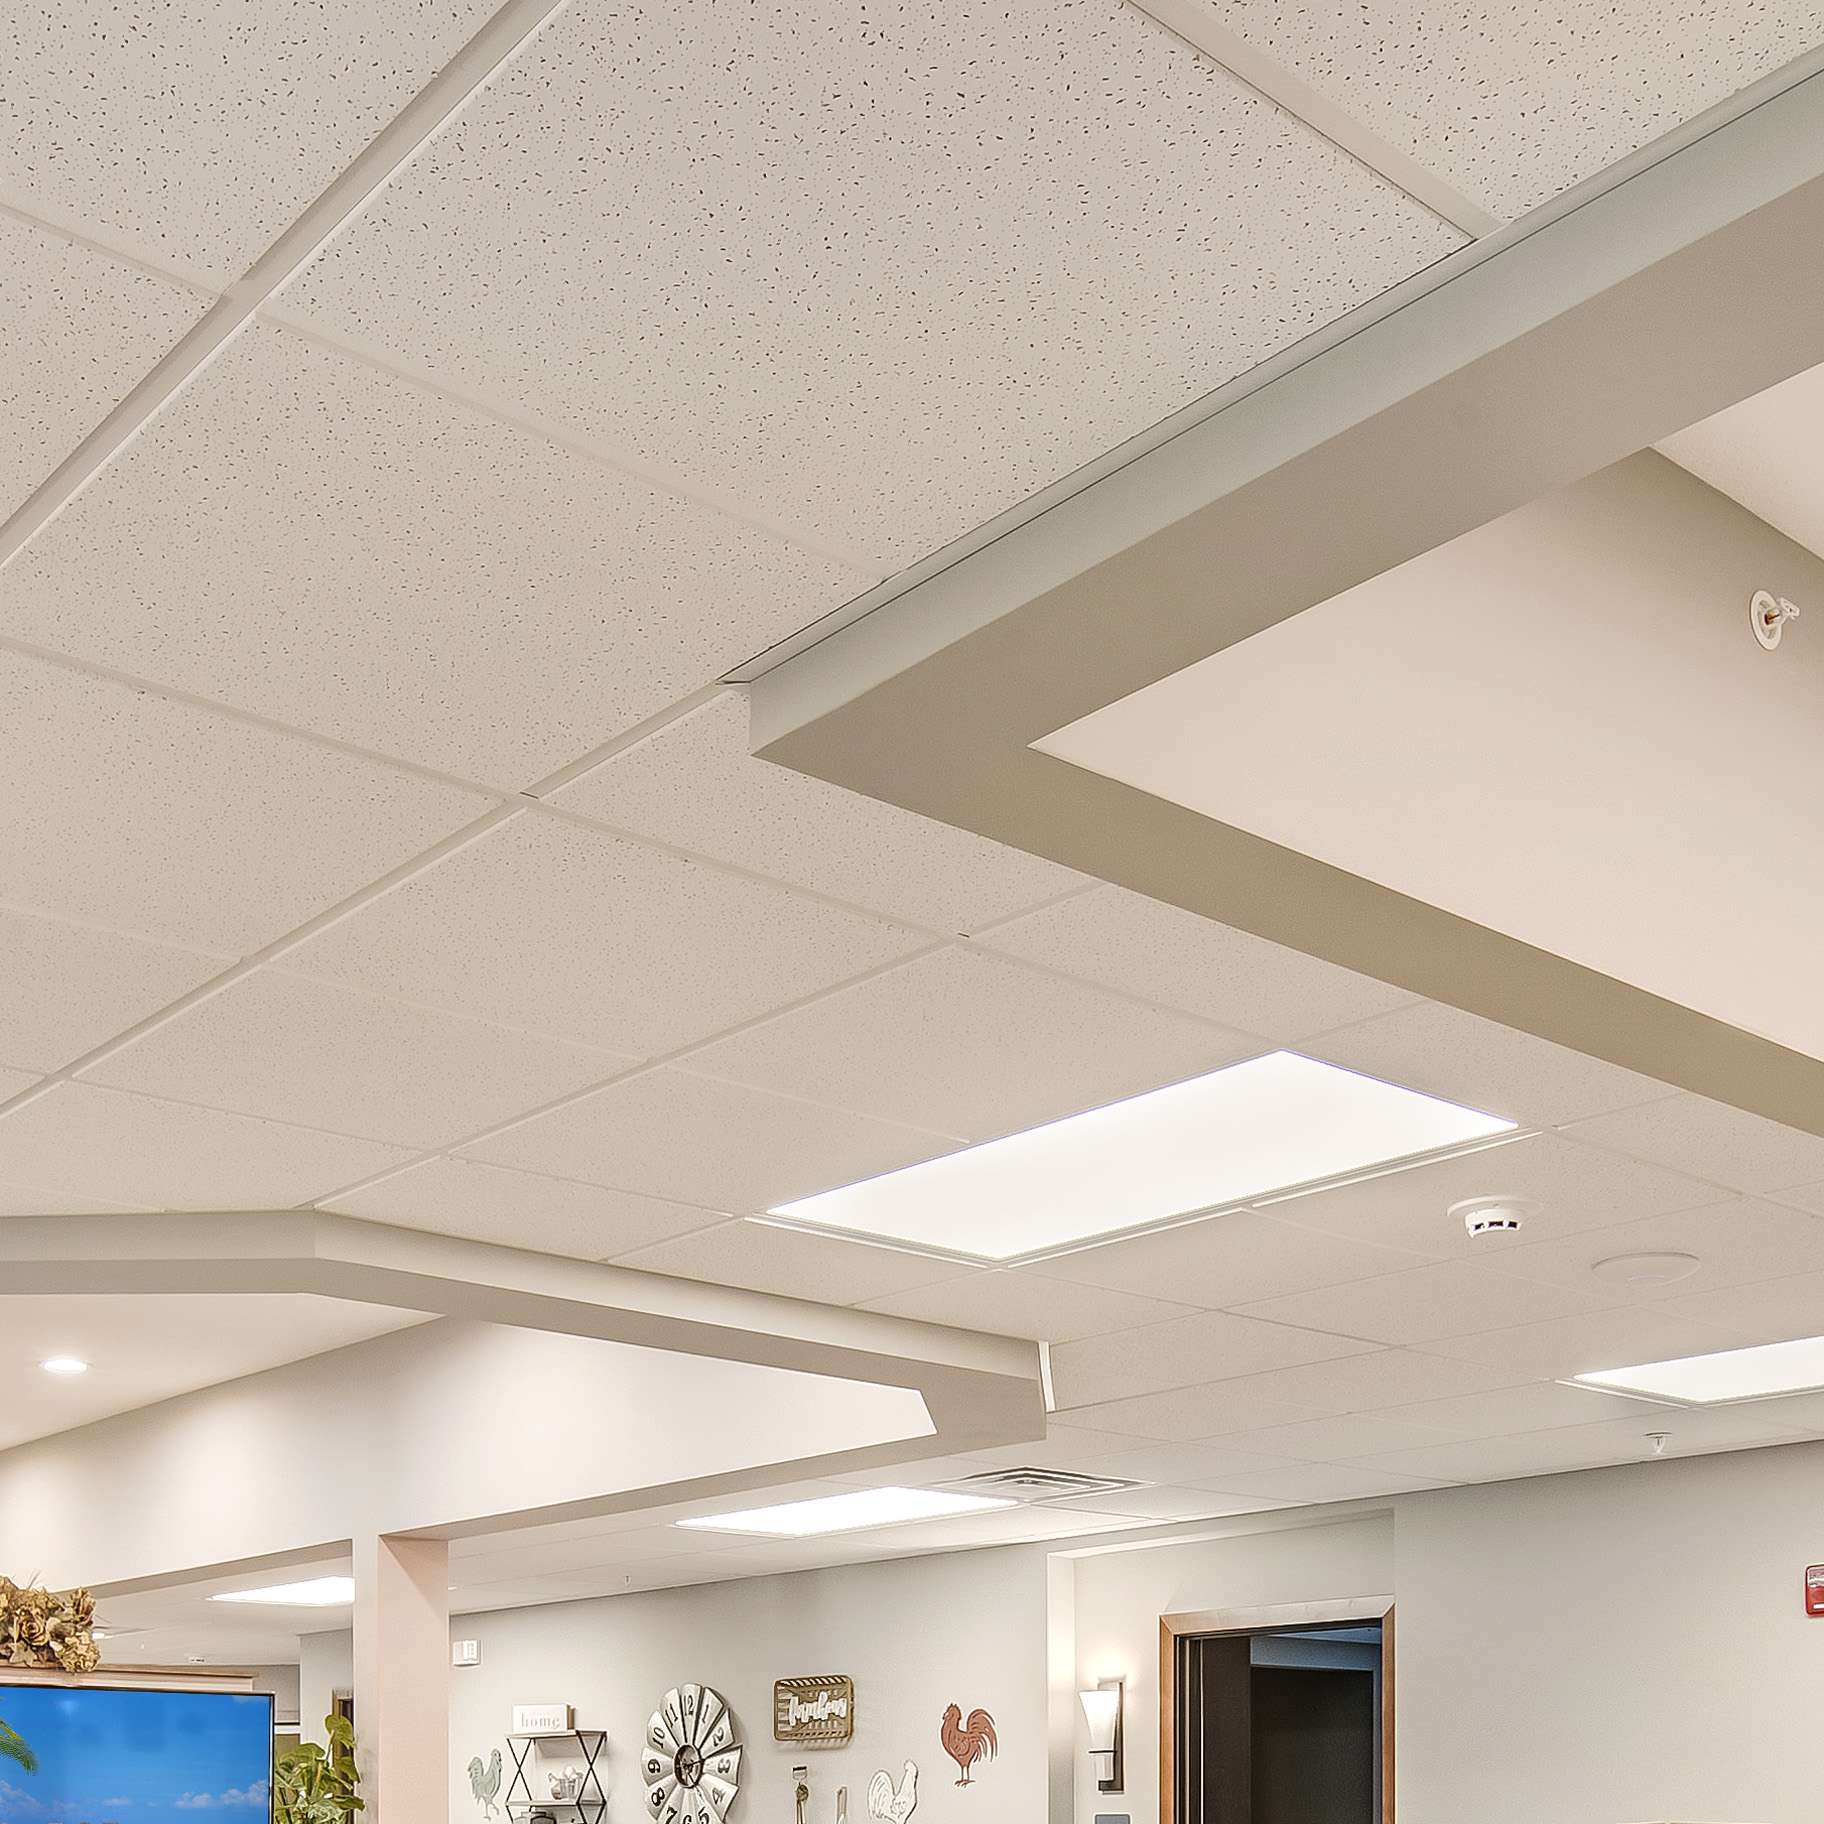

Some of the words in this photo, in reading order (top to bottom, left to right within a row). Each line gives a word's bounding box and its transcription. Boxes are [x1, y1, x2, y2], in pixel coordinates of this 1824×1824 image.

[683, 1694, 694, 1716] 12
[702, 1704, 710, 1724] 1
[521, 1712, 561, 1730] home
[652, 1726, 666, 1749] 10
[712, 1726, 725, 1747] 2
[717, 1758, 732, 1774] 3
[651, 1787, 666, 1807] 8
[712, 1787, 726, 1805] 4
